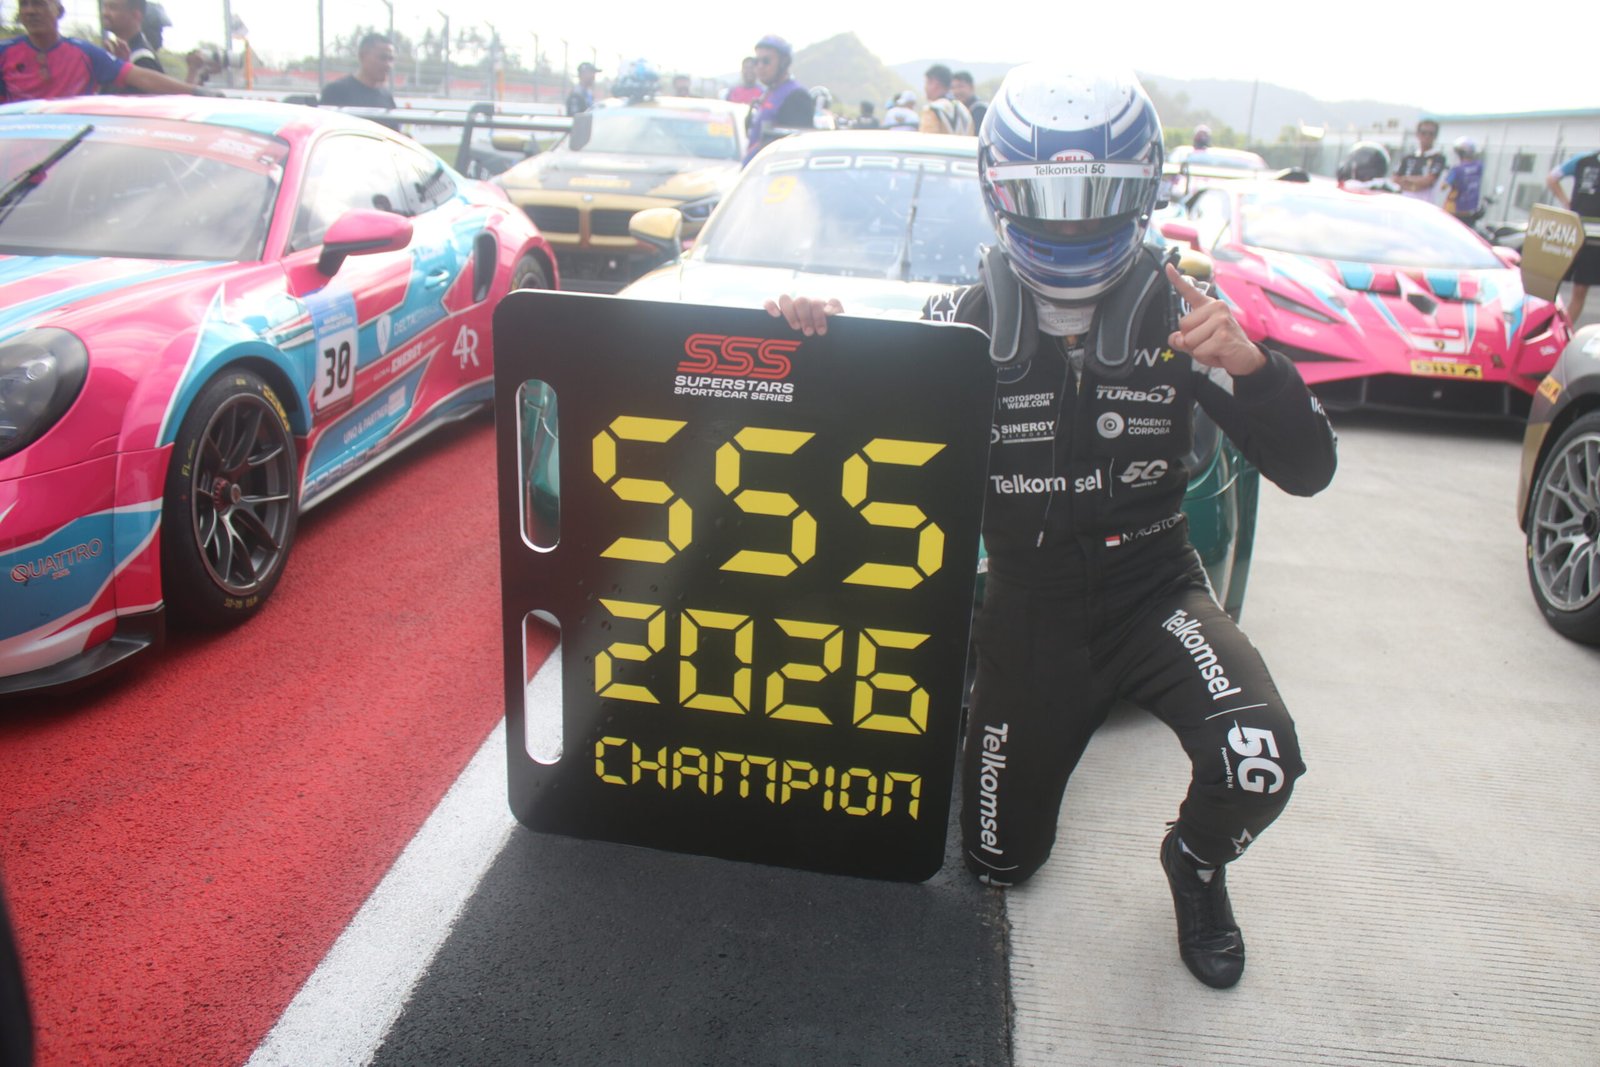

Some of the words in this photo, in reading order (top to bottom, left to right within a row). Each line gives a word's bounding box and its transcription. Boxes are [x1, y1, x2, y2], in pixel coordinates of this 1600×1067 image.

[764, 155, 979, 177] PORSC
[1034, 164, 1088, 176] Telkomsel
[1090, 164, 1106, 175] 5G
[764, 175, 798, 205] 9
[322, 340, 351, 398] 30
[676, 333, 802, 380] SSS
[673, 386, 748, 399] SPORTSCAR
[750, 392, 793, 403] SERIES
[674, 375, 794, 394] SUPERSTARS
[1096, 388, 1164, 402] TURBO
[1007, 399, 1051, 409] WEAR.COM
[1128, 417, 1171, 427] MAGENTA
[1128, 426, 1171, 435] CORPORA
[1118, 459, 1168, 483] 5G
[10, 538, 103, 583] QUATTRO
[595, 598, 932, 735] 2026
[1161, 609, 1242, 701] Telkomsel
[1227, 720, 1285, 794] 5G
[595, 736, 922, 821] CHAMPION
[979, 723, 1008, 855] Telkomsel
